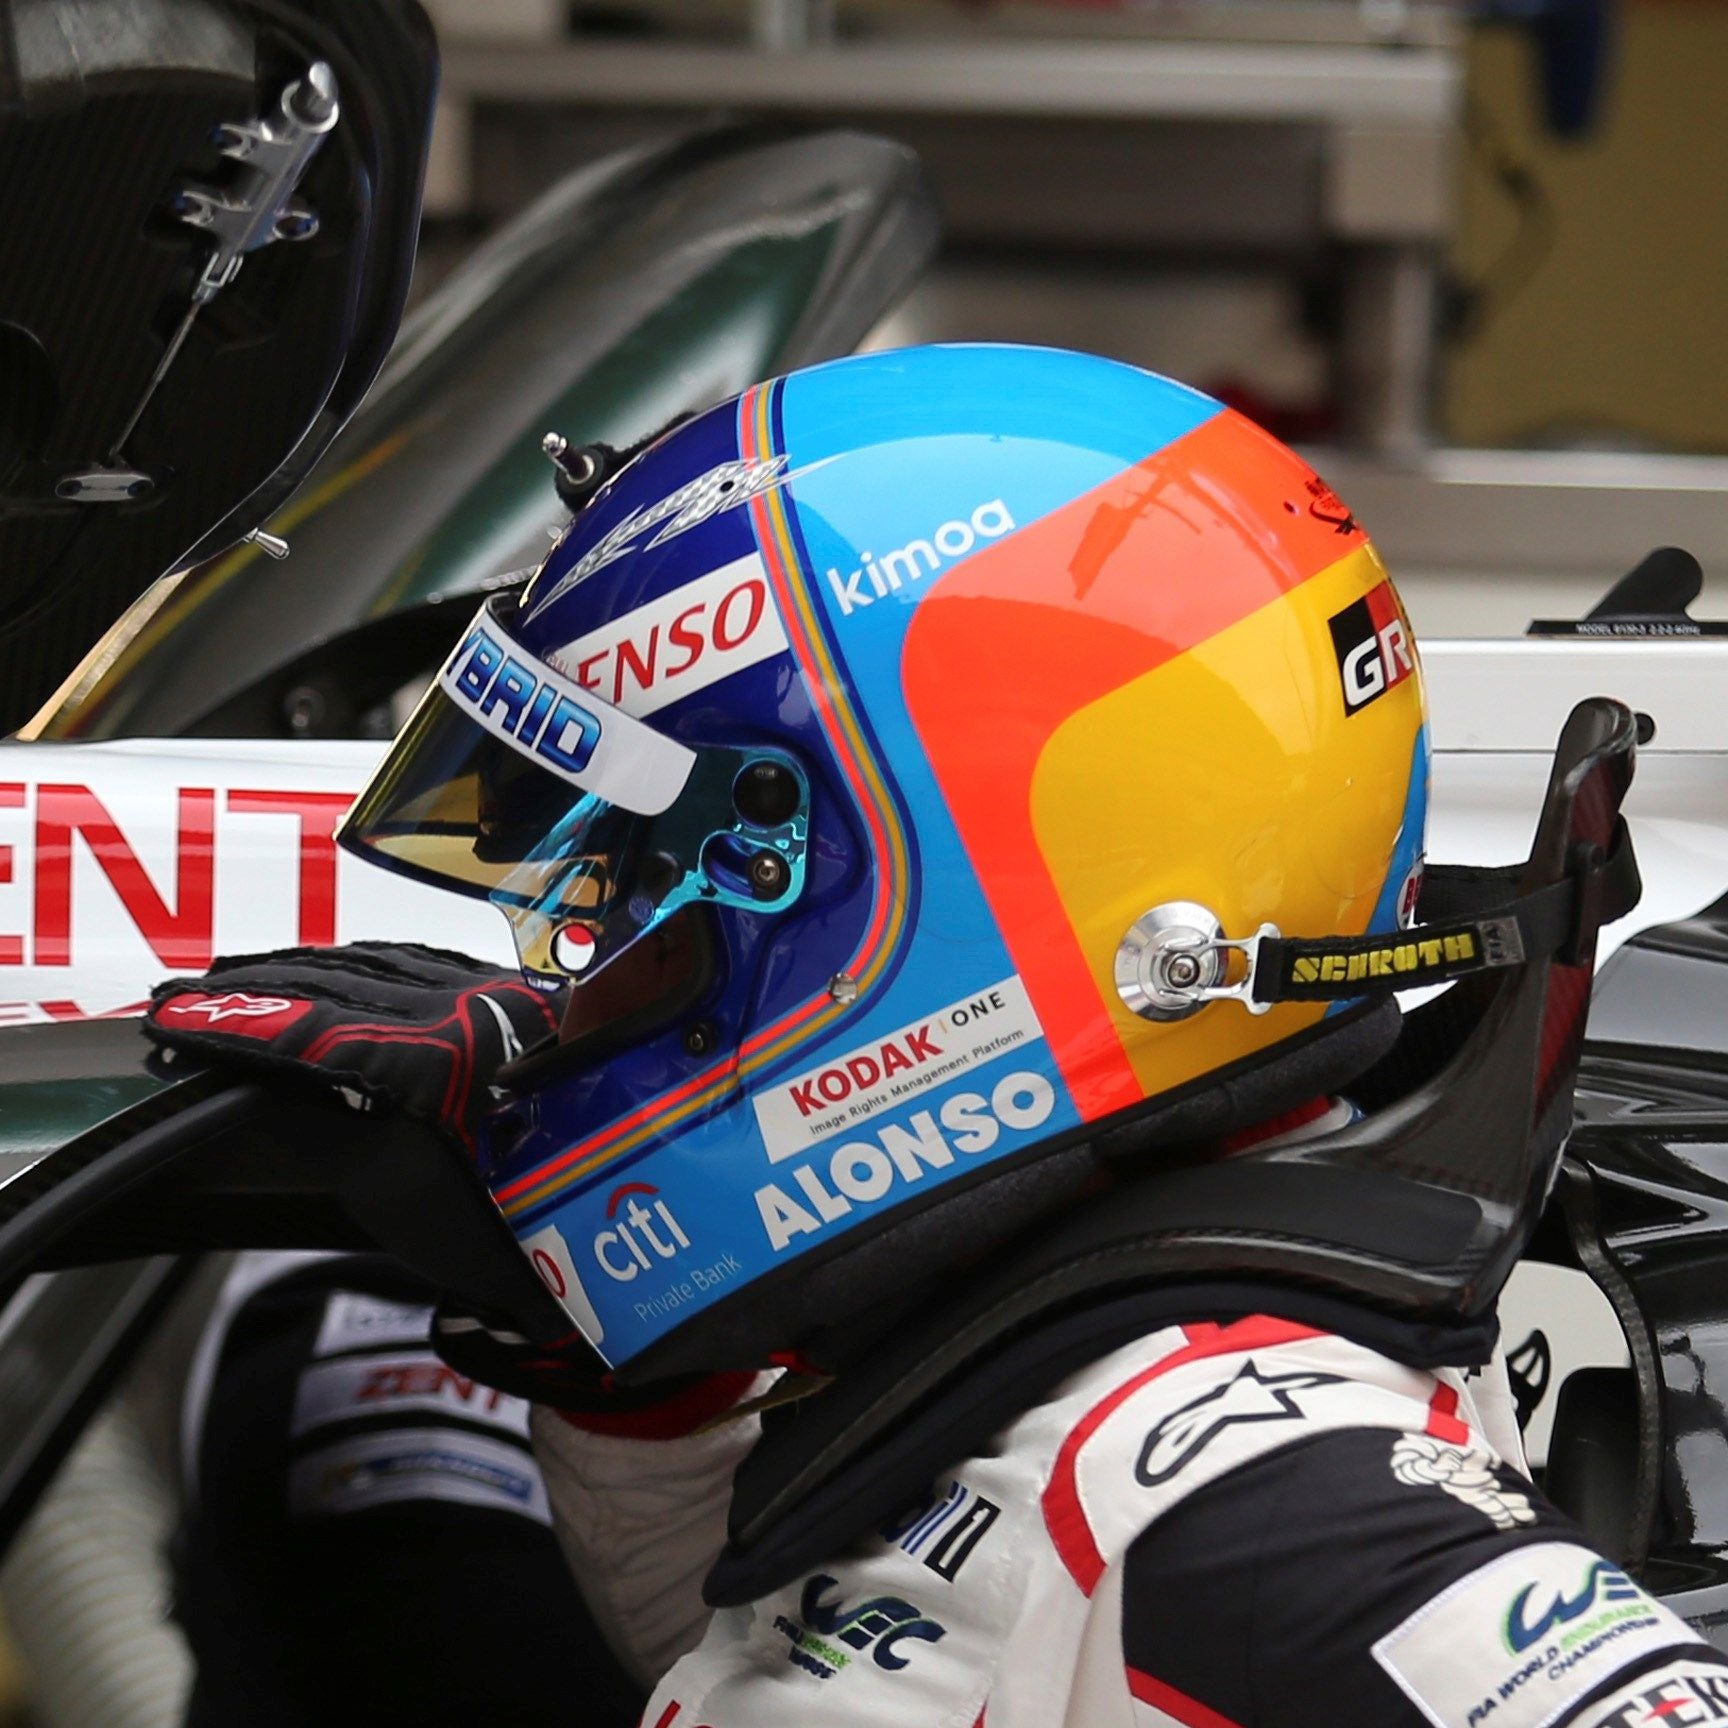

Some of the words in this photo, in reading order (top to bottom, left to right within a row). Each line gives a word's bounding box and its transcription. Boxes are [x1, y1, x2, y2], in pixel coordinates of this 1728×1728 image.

[827, 499, 1014, 615] kimoa
[577, 578, 766, 706] ENSO
[1340, 612, 1413, 708] GR
[1291, 932, 1475, 983] SCHROTH
[789, 1025, 944, 1116] KODAK
[951, 992, 1005, 1027] ONE
[810, 1114, 846, 1135] Image
[849, 1094, 888, 1118] Rights
[890, 1055, 969, 1099] Management
[972, 1029, 1023, 1059] Platform
[754, 1071, 1055, 1252] ALONSO
[594, 1198, 692, 1281] citi
[634, 1283, 696, 1323] Private
[690, 1253, 743, 1292] Bank
[1498, 1646, 1559, 1700] WORLD
